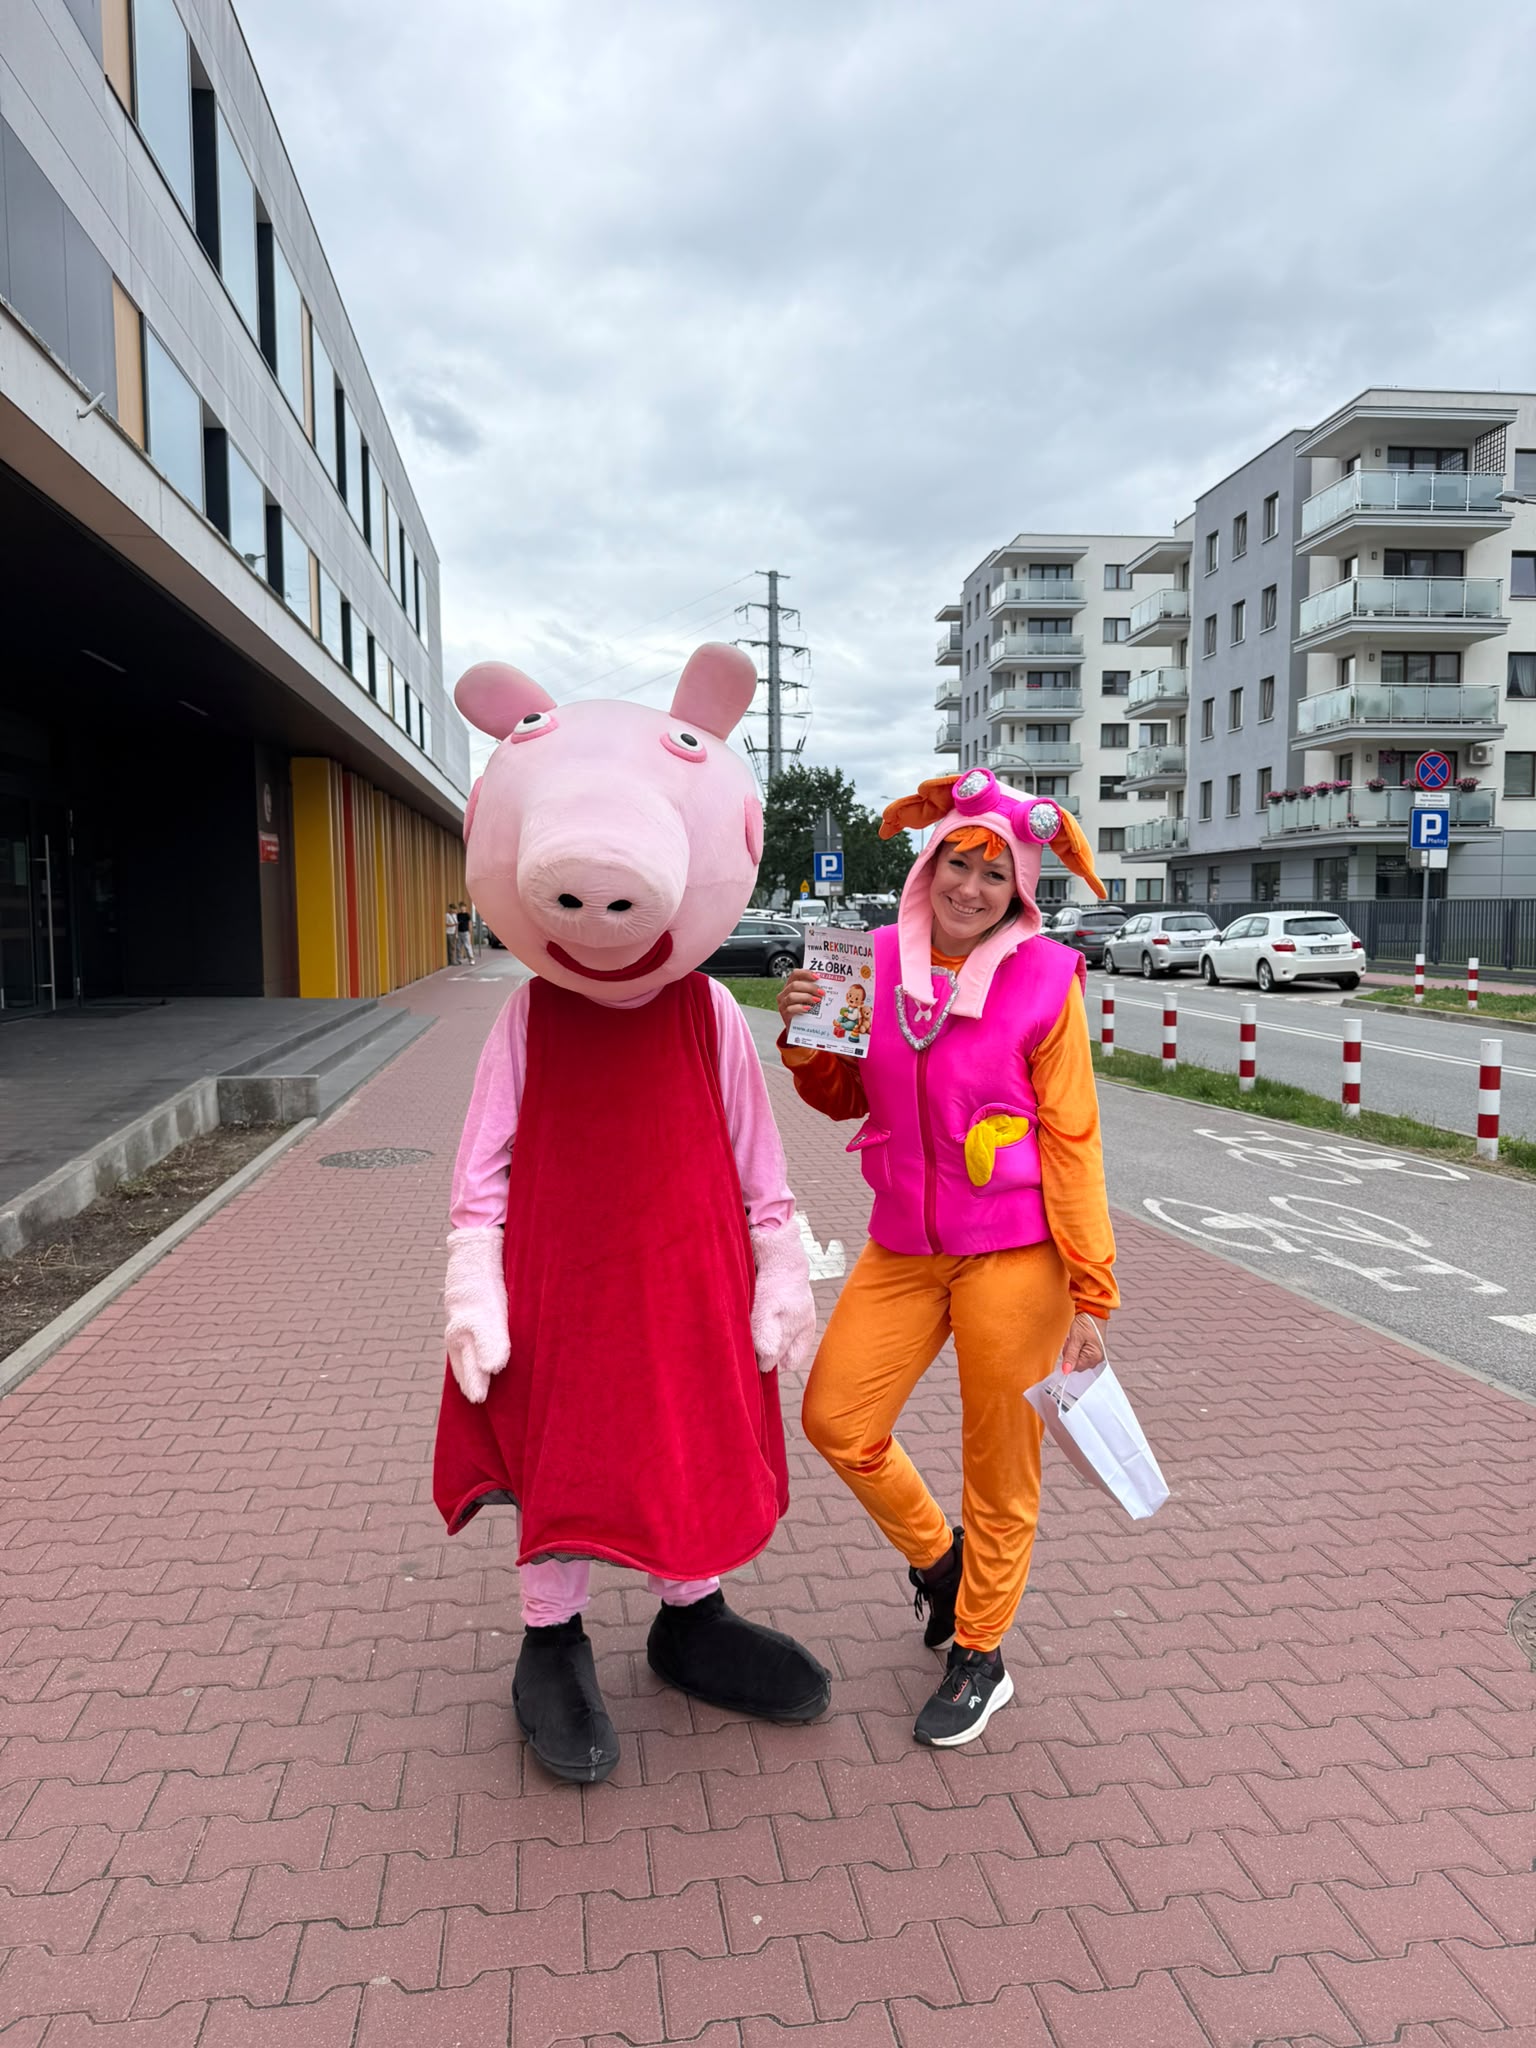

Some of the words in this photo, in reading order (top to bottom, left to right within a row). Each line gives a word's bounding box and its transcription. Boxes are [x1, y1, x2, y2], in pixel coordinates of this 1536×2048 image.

[1420, 814, 1442, 843] P
[820, 855, 838, 878] P
[823, 940, 873, 958] REKRUTACJA
[809, 957, 854, 976] ŻŁOBKA
